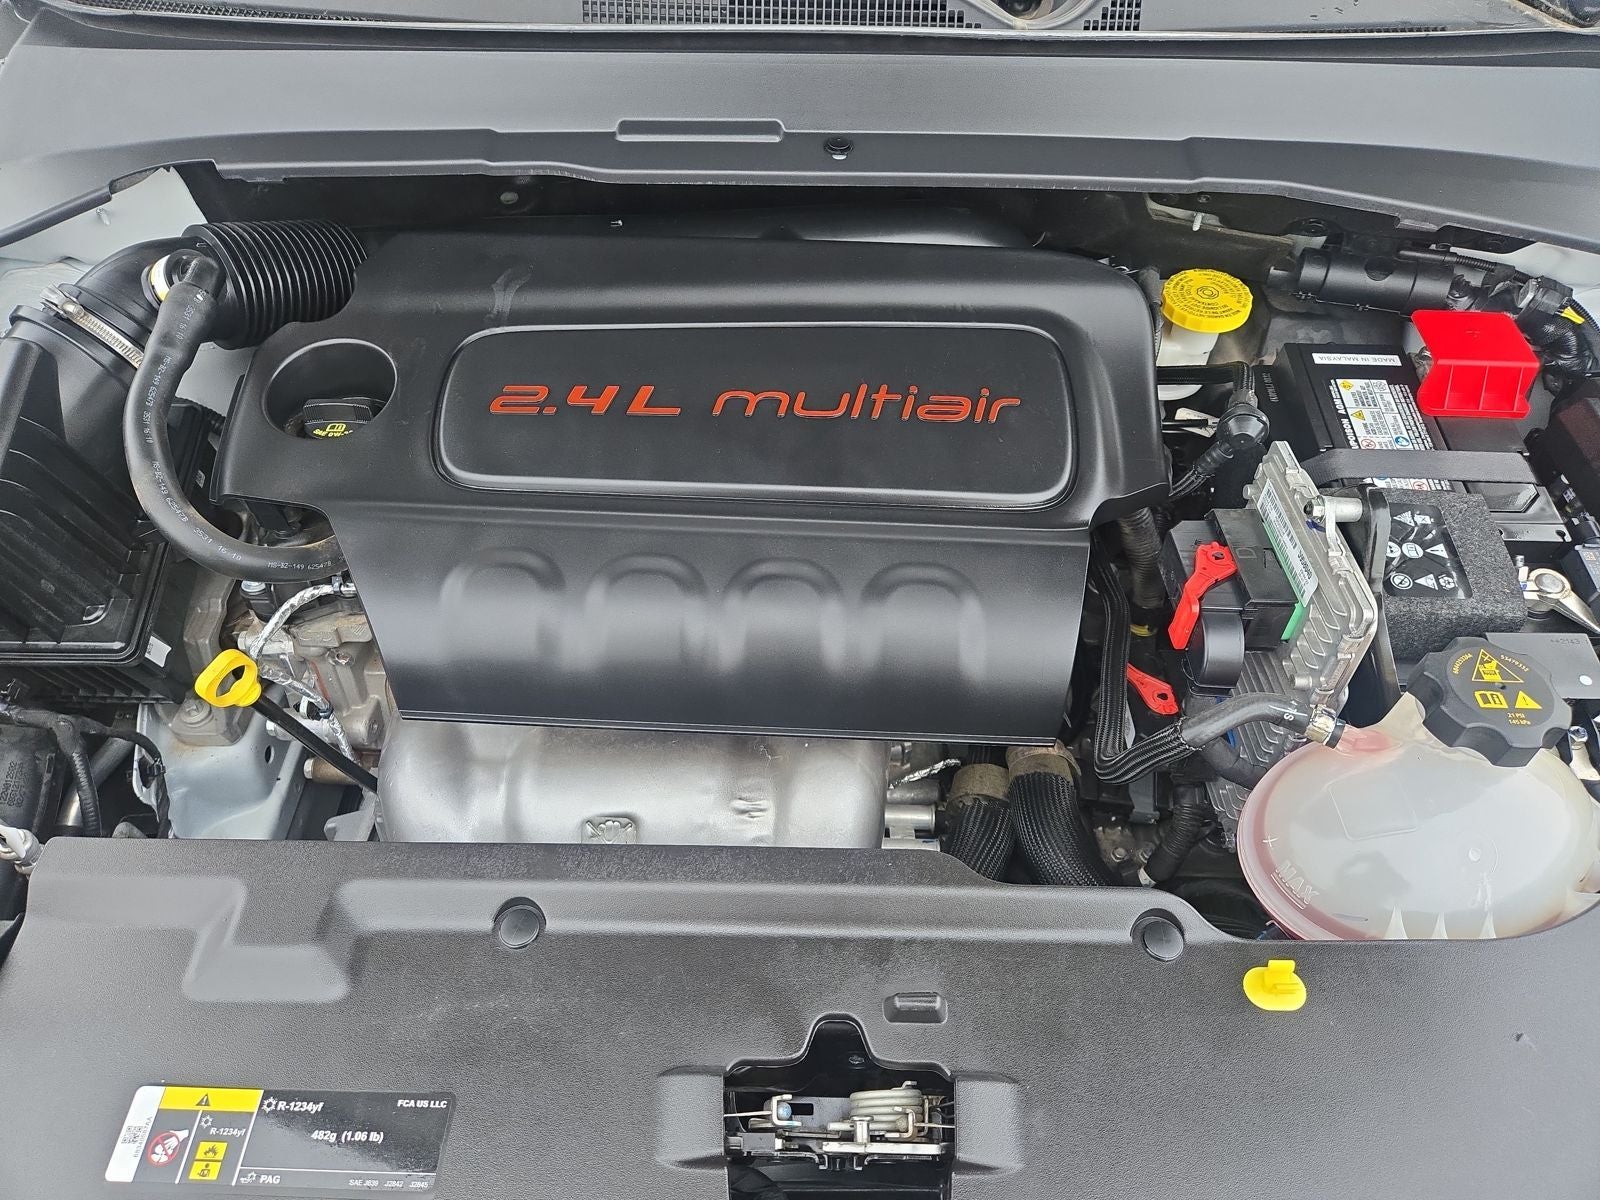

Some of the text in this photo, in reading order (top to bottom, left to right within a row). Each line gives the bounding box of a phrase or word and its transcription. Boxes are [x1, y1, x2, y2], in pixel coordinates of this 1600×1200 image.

[713, 384, 1022, 424] multiair
[276, 1099, 447, 1114] R-1234yf FCA US LLC
[210, 1127, 246, 1138] R-1234yf
[311, 1130, 384, 1144] 482g (1.06 lb)
[259, 1174, 280, 1184] PAG
